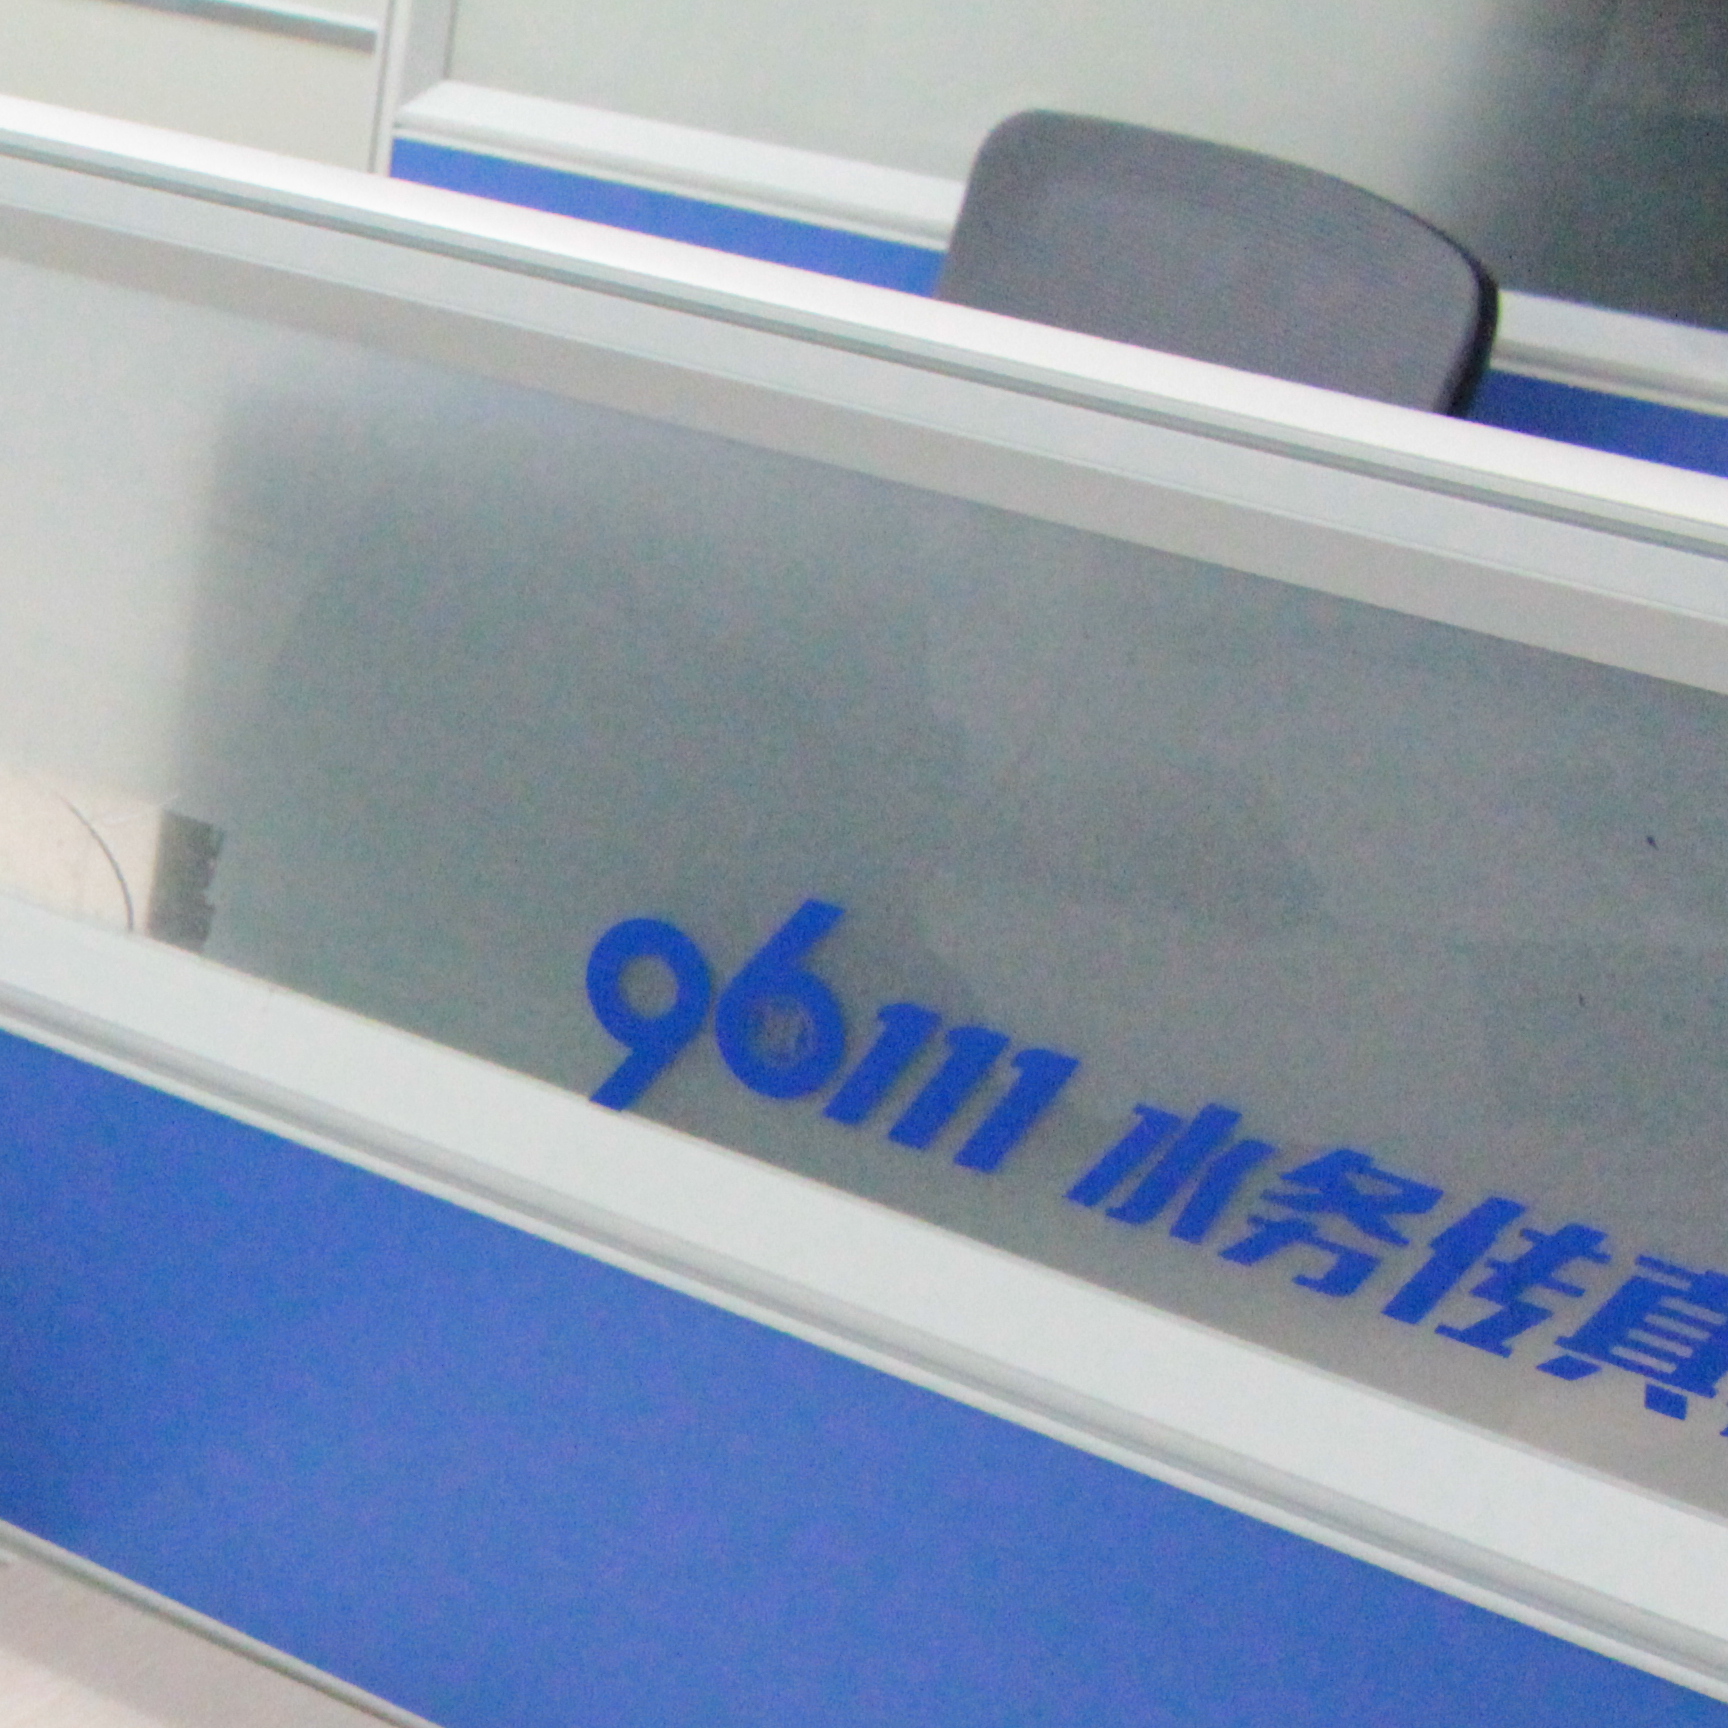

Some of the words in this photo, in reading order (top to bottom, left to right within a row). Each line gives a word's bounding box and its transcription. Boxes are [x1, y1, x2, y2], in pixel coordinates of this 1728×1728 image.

[585, 898, 1080, 1174] 96111
[1065, 1102, 1728, 1437] 水务传真
